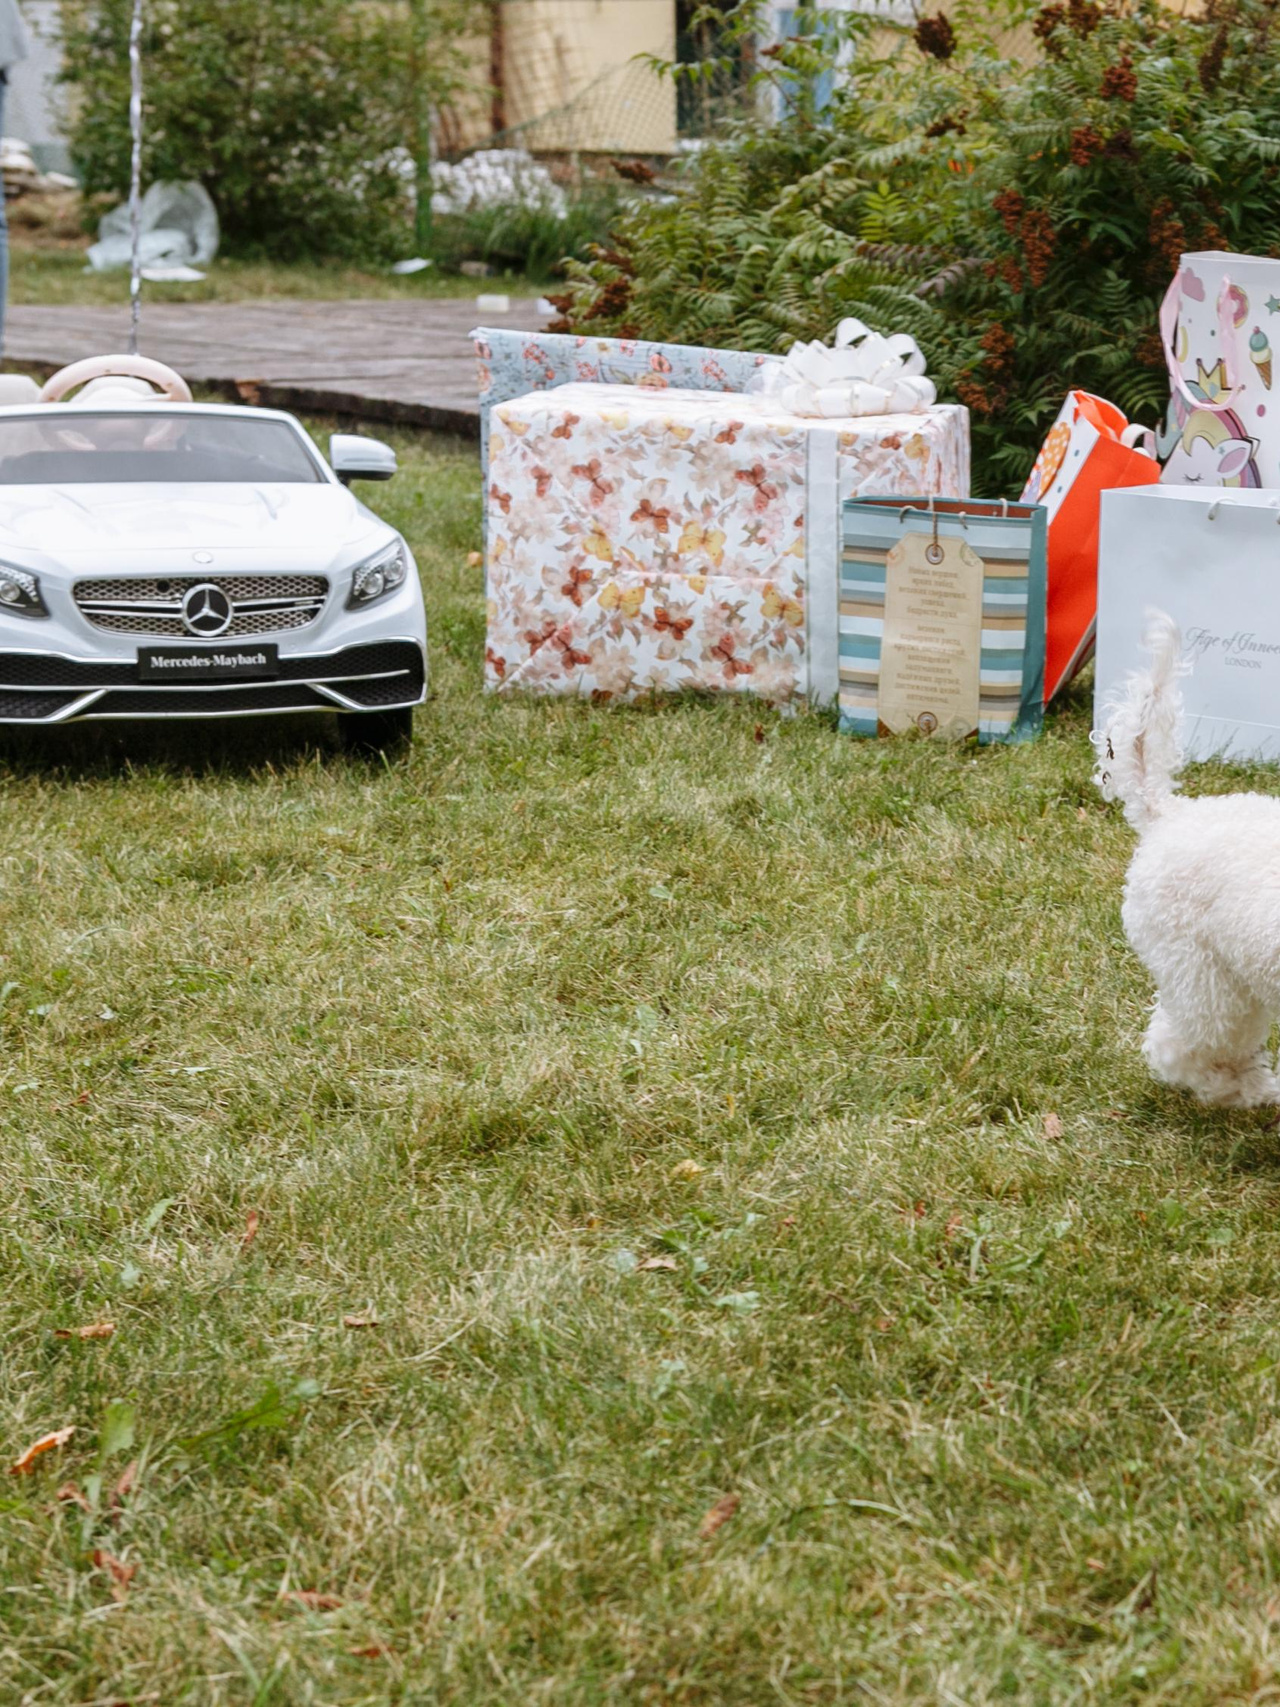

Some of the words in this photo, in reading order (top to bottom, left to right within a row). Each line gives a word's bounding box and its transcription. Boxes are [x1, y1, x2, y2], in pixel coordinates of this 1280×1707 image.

[1222, 631, 1241, 653] of
[150, 653, 267, 668] Mercedes-Maybach
[1224, 656, 1262, 669] LONDON
